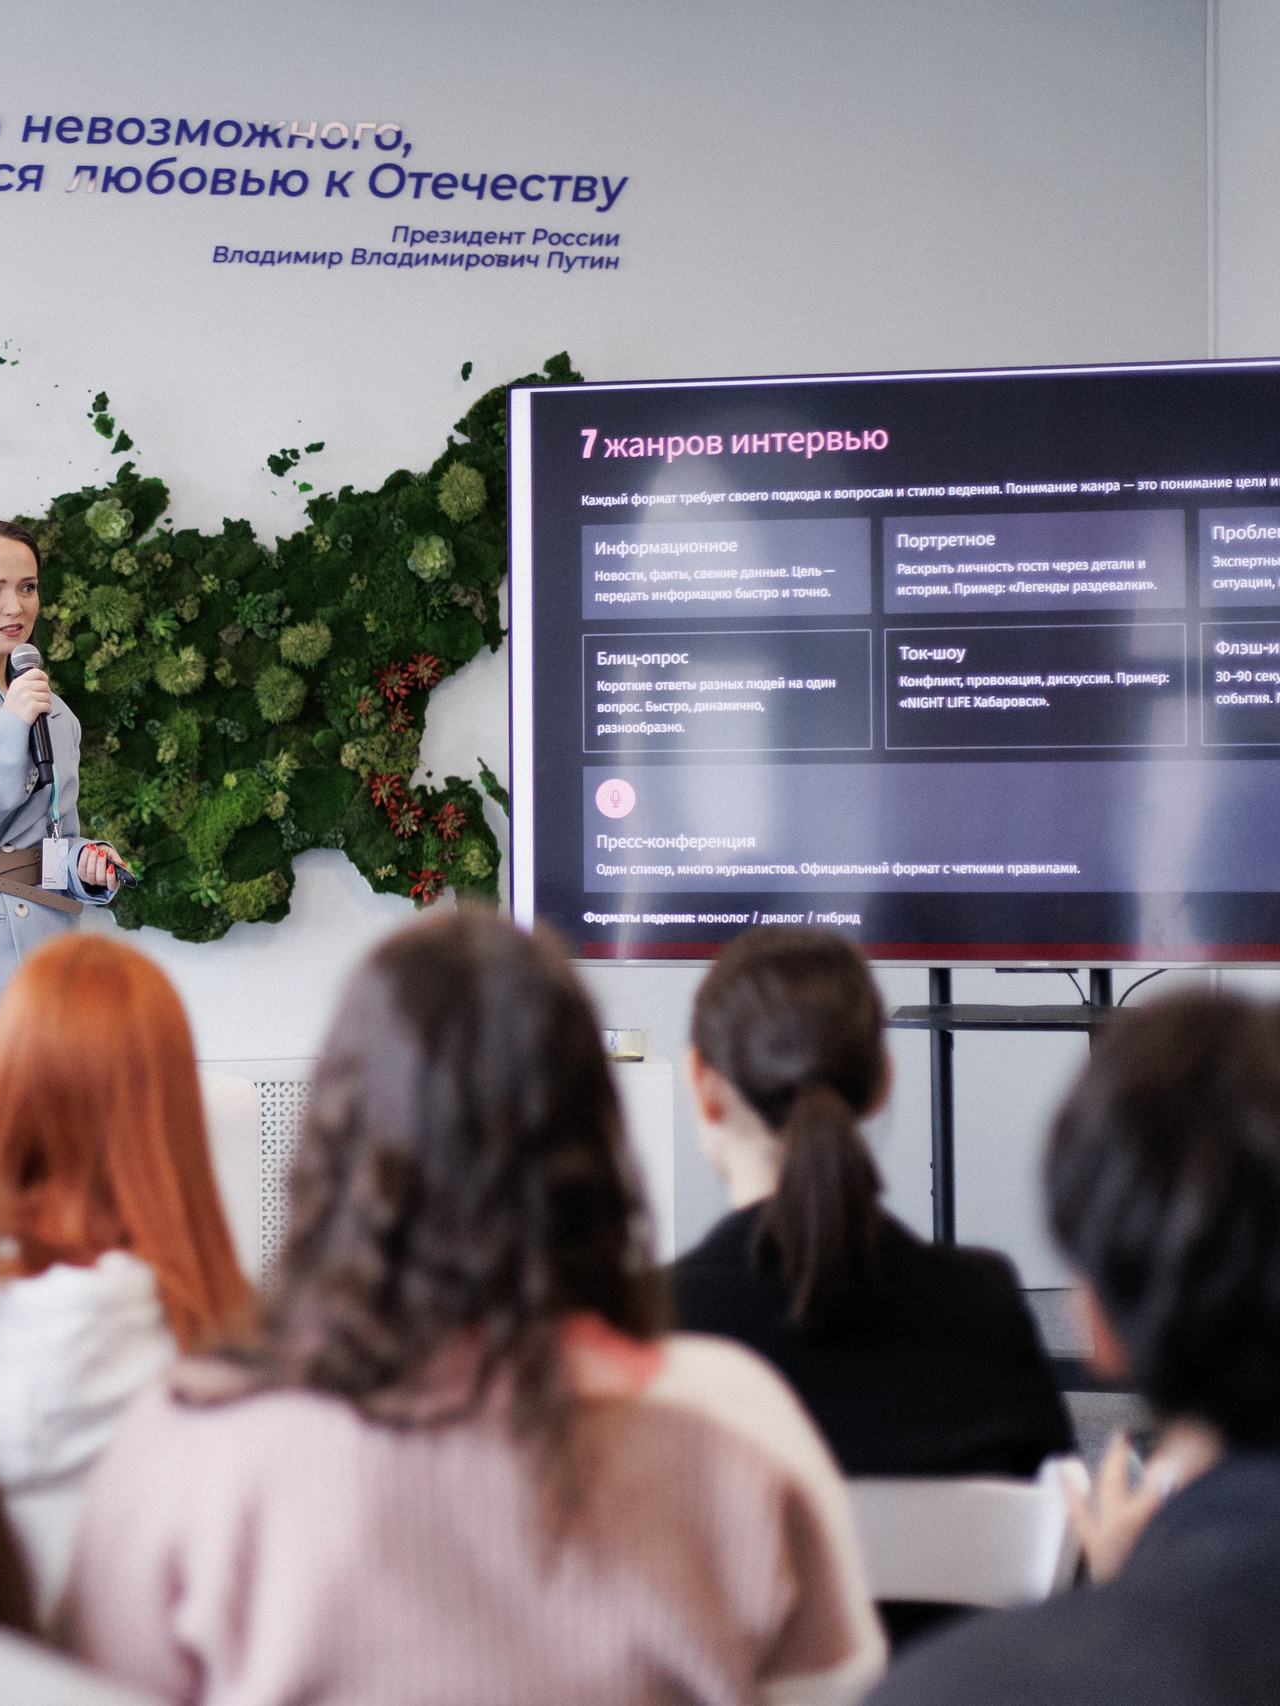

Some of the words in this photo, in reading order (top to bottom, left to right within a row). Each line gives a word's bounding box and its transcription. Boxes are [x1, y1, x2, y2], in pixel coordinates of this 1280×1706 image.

[21, 114, 412, 158] невозможного,
[65, 157, 309, 197] любовью
[325, 170, 355, 197] к
[368, 162, 628, 212] Отечеству
[391, 226, 525, 249] Президент
[531, 228, 620, 246] России
[213, 245, 343, 268] Владимир
[350, 247, 539, 270] Владимирович
[546, 252, 619, 274] Путин
[581, 428, 598, 459] 7
[604, 434, 723, 463] жанров
[731, 428, 889, 459] интервью
[582, 493, 628, 506] Каждый
[631, 491, 677, 506] формат
[679, 491, 726, 505] требует
[728, 491, 769, 502] своего
[771, 489, 821, 503] подхода
[824, 489, 831, 499] к
[834, 488, 893, 501] вопросам
[897, 487, 904, 497] и
[908, 486, 945, 497] стилю
[948, 484, 1003, 496] ведения.
[1006, 481, 1078, 494] Понимание
[1081, 482, 1120, 494] жанра
[1138, 480, 1158, 491] это
[1161, 479, 1233, 490] понимание
[1236, 477, 1267, 489] цели
[595, 540, 738, 557] Информационное
[897, 532, 995, 551] Портретное
[595, 569, 647, 583] Новости,
[650, 568, 691, 583] факты,
[694, 569, 738, 580] свежие
[740, 567, 789, 580] данные.
[792, 565, 821, 579] Цель
[897, 562, 954, 576] Раскрыть
[957, 561, 1014, 573] личность
[1018, 561, 1050, 572] гостя
[1052, 560, 1088, 573] через
[1091, 558, 1135, 572] детали
[1138, 559, 1146, 569] и
[897, 583, 950, 598] истории.
[954, 582, 1006, 597] Пример:
[1009, 581, 1069, 595] «Легенды
[1073, 580, 1157, 595] раздевалки».
[1213, 578, 1275, 591] ситуации,
[595, 590, 649, 604] передать
[652, 588, 732, 603] информацию
[735, 587, 779, 601] быстро
[782, 588, 789, 598] и
[793, 588, 831, 598] точно.
[597, 650, 689, 668] Блиц-опрос
[900, 646, 966, 663] Ток-шоу
[597, 680, 652, 694] Короткие
[655, 679, 697, 691] ответы
[700, 679, 743, 692] разных
[746, 676, 785, 691] людей
[788, 679, 803, 689] на
[806, 678, 836, 690] один
[900, 675, 964, 688] Конфликт,
[966, 674, 1044, 687] провокация,
[1047, 673, 1114, 686] дискуссия.
[1116, 672, 1170, 686] Пример:
[900, 697, 944, 708] «NIGHT
[947, 697, 971, 708] LIFE
[974, 696, 1050, 709] Хабаровск».
[1216, 692, 1274, 704] события.
[597, 702, 642, 715] вопрос.
[646, 700, 692, 714] Быстро,
[694, 700, 764, 714] динамично,
[597, 721, 685, 736] разнообразно.
[597, 833, 755, 852] Пресс-конференция
[597, 863, 627, 876] Один
[630, 864, 675, 877] спикер,
[677, 865, 714, 875] много
[716, 864, 798, 877] журналистов.
[801, 862, 889, 876] Официальный
[892, 861, 940, 876] формат
[943, 864, 950, 874] с
[952, 863, 1004, 874] четкими
[1007, 863, 1081, 876] правилами.
[583, 911, 641, 926] Форматы
[643, 912, 696, 924] ведения:
[698, 913, 749, 923] монолог
[752, 911, 758, 925] /
[761, 912, 804, 925] диалог
[807, 911, 813, 925] /
[817, 911, 861, 925] гибрид
